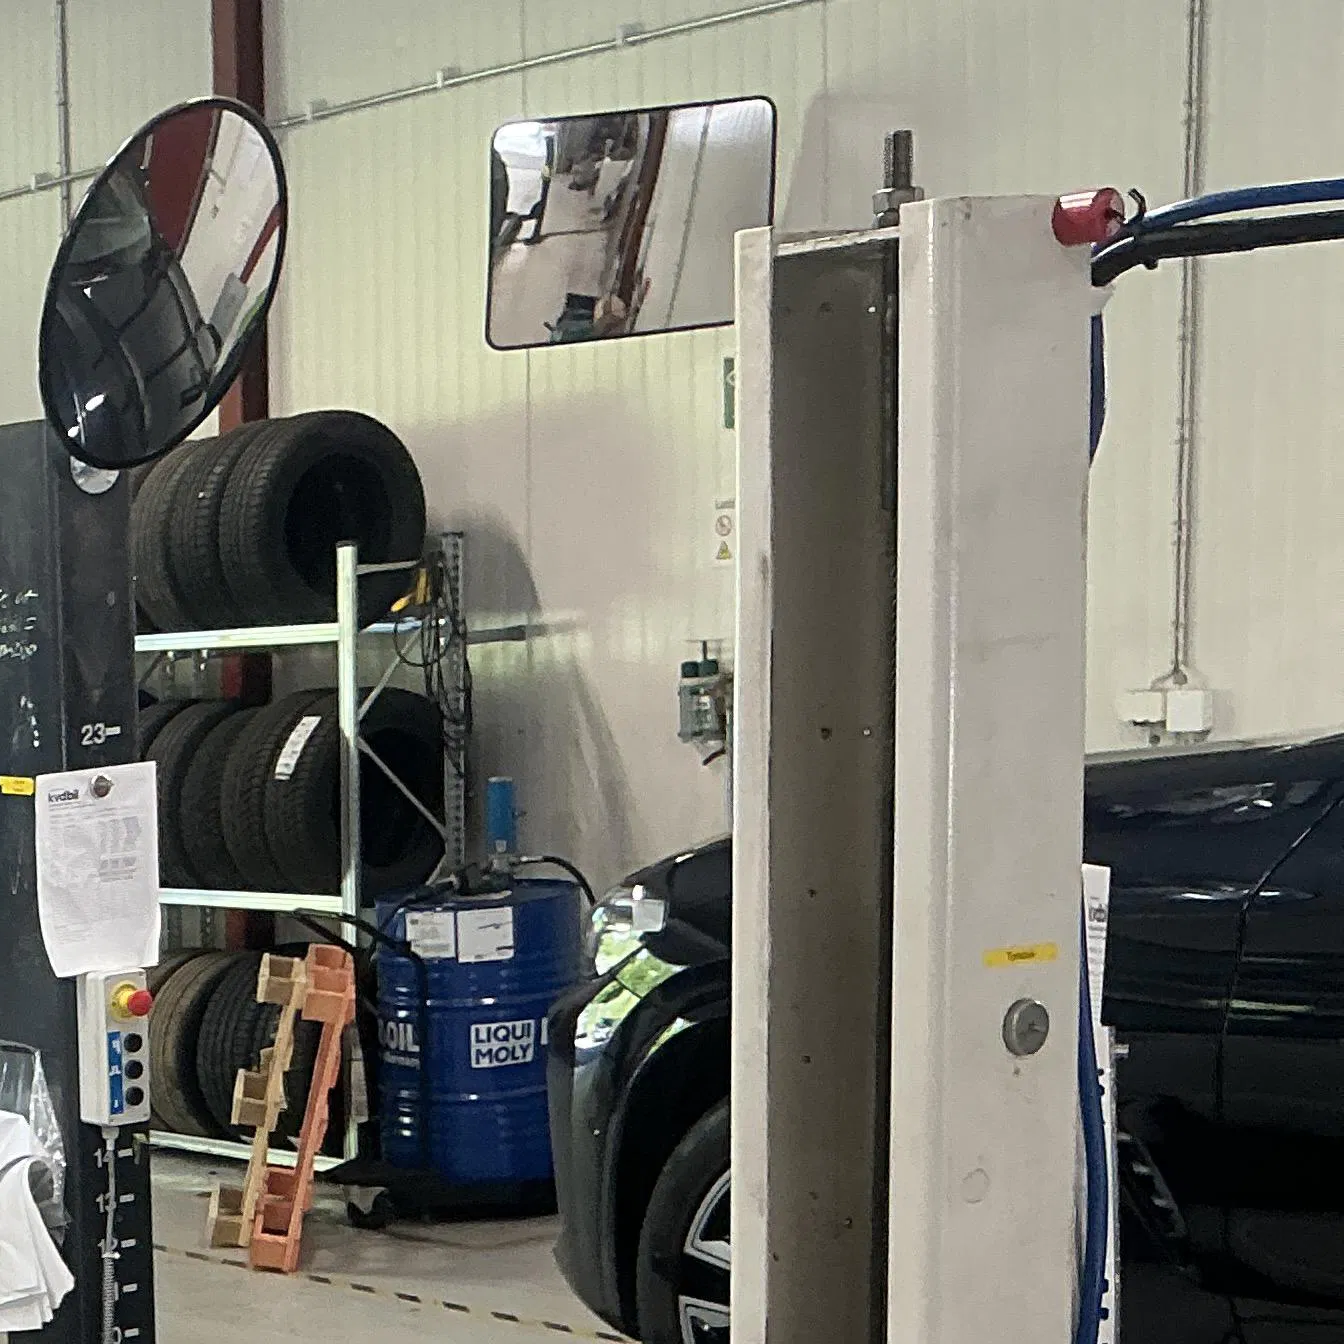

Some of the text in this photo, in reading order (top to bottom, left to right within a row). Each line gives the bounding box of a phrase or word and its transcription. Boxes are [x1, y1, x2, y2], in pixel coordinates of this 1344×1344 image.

[81, 722, 106, 746] 23
[474, 1022, 531, 1043] LIQUI
[474, 1043, 530, 1065] MOLY
